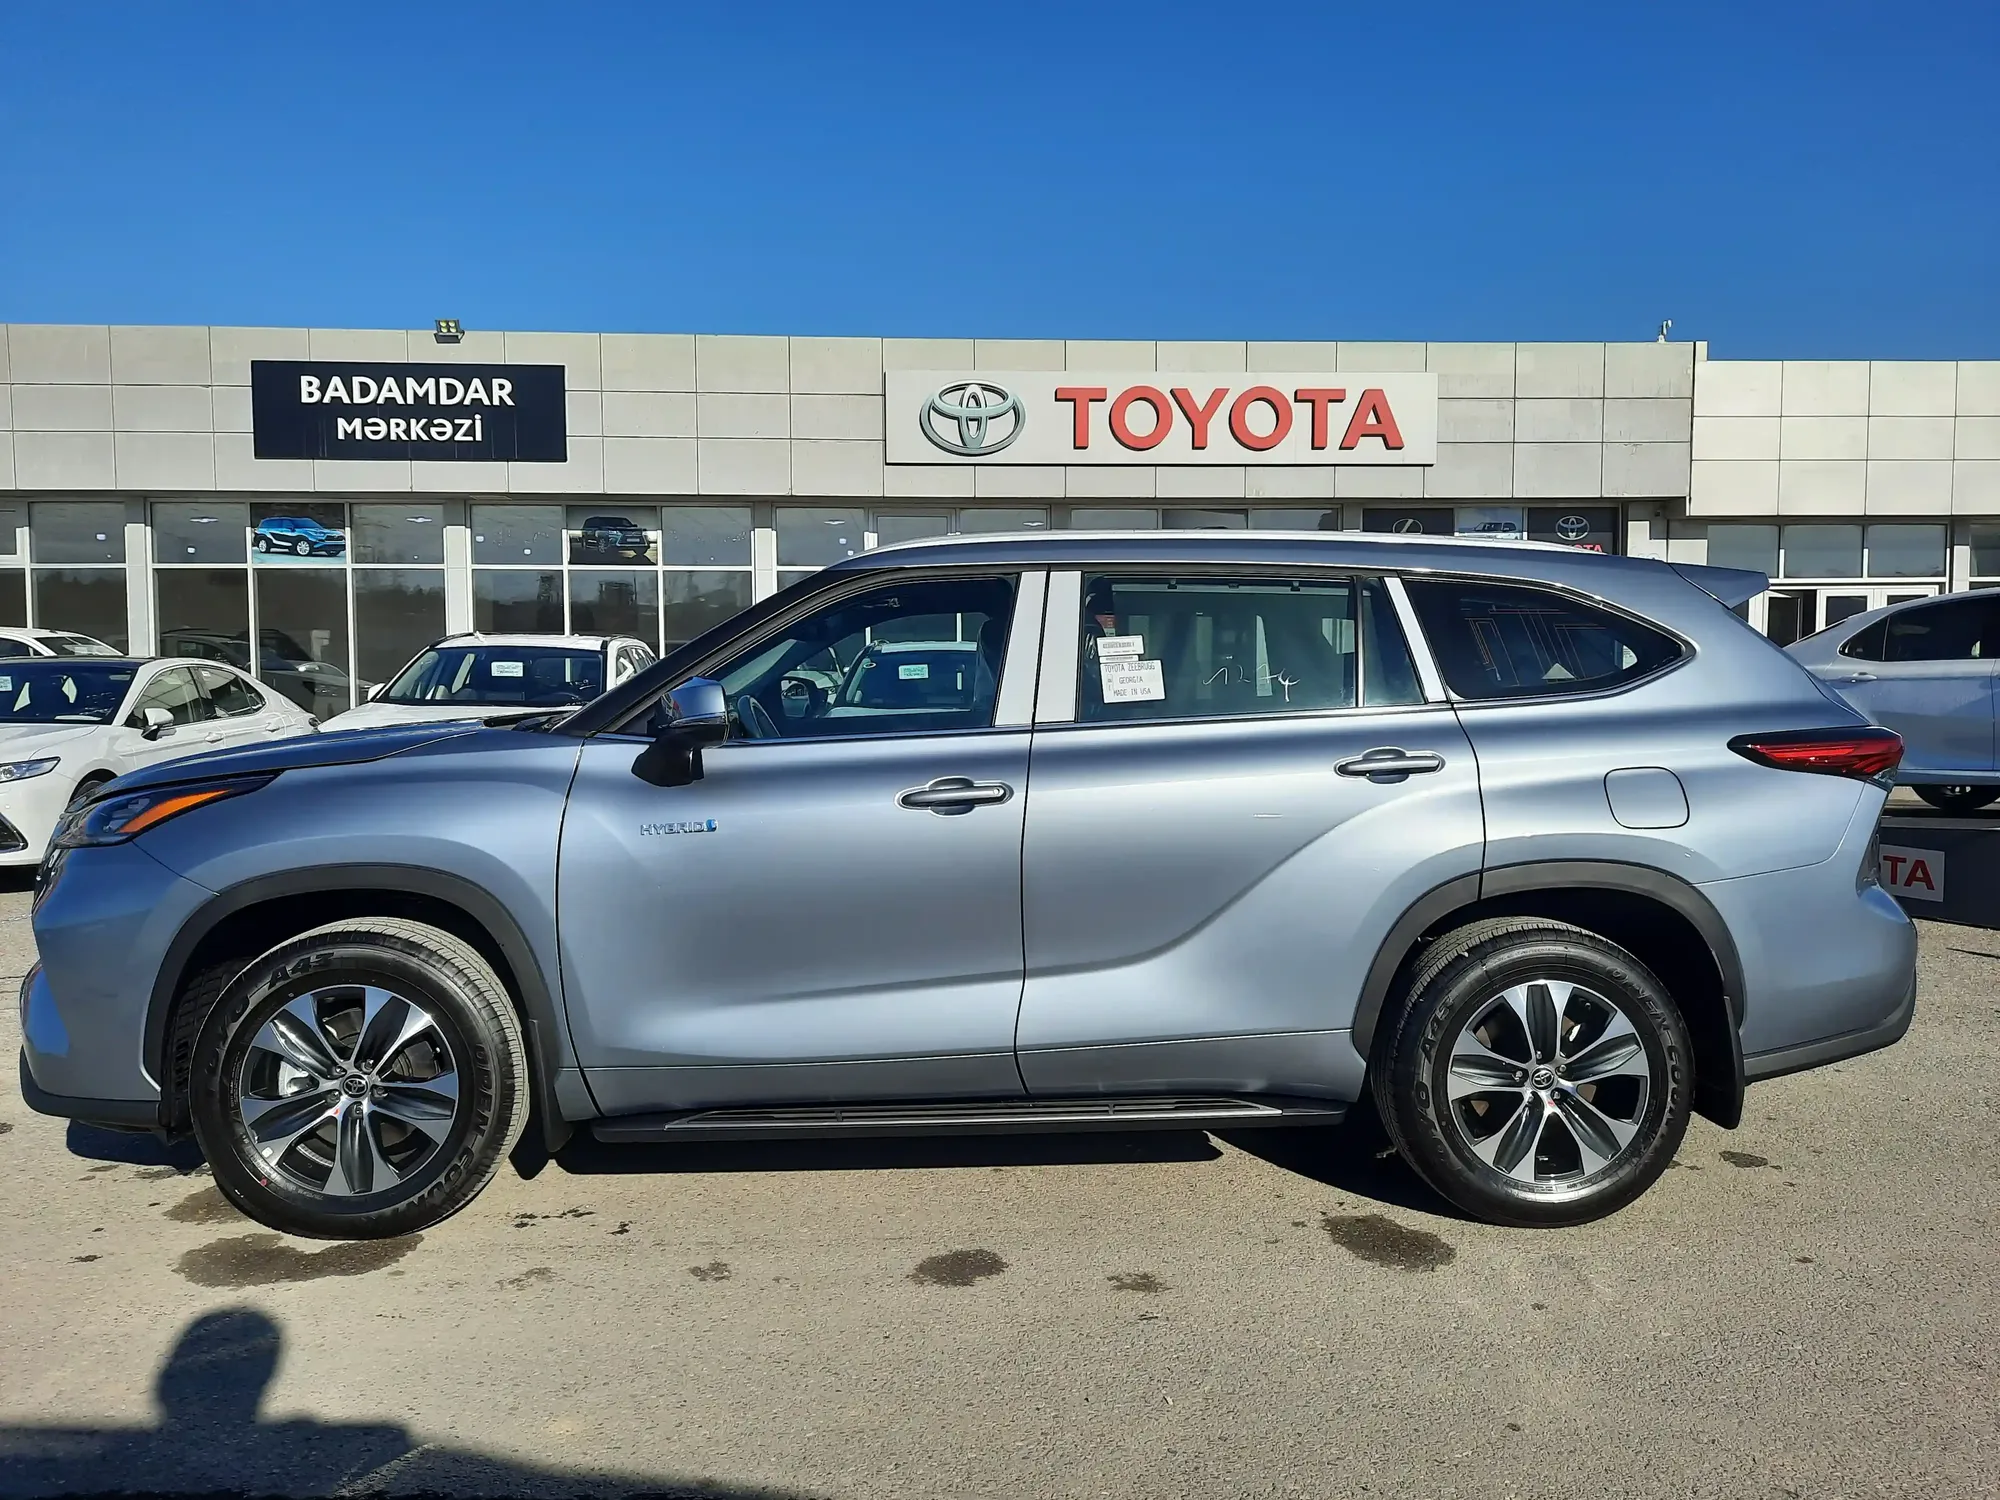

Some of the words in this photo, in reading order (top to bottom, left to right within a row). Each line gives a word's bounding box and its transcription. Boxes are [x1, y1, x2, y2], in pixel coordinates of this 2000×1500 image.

[300, 375, 515, 406] BADAMDAR
[1055, 385, 1404, 451] TOYOTA
[1104, 664, 1125, 673] TOYOTA
[1119, 676, 1143, 684] GEORGIA
[1131, 688, 1138, 696] IN
[1141, 687, 1151, 695] USA
[640, 822, 704, 835] HYBRID
